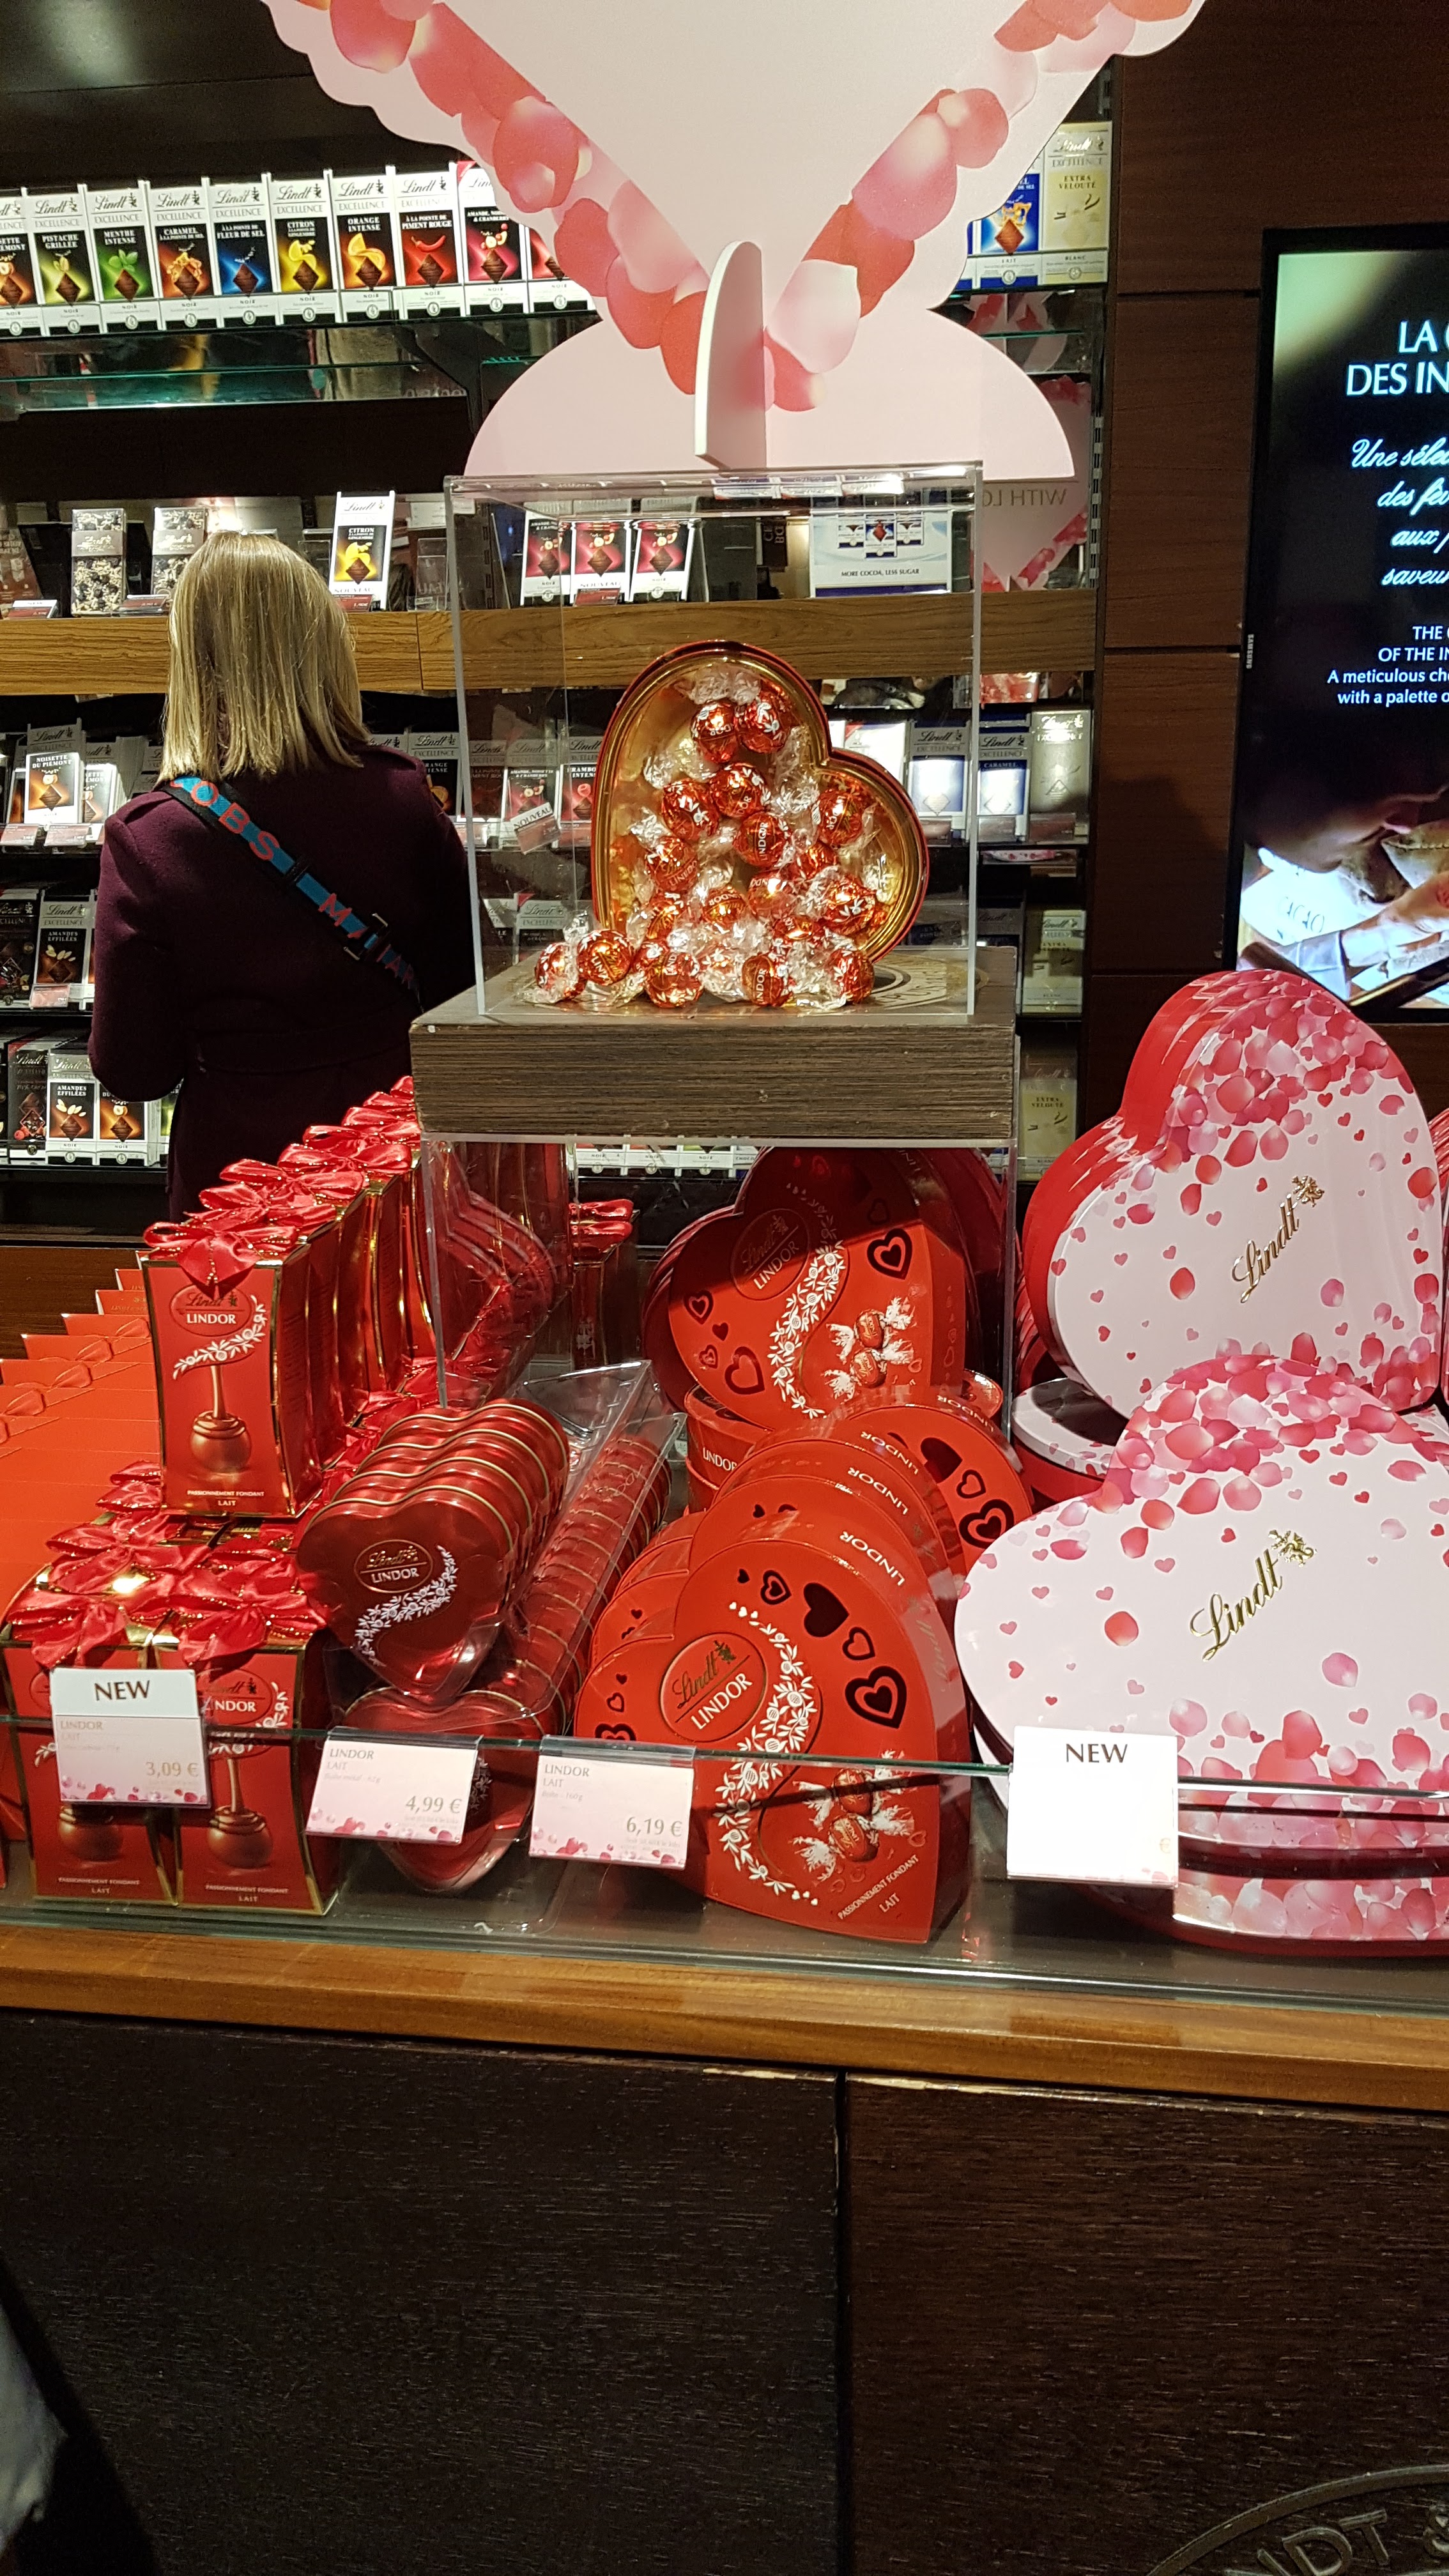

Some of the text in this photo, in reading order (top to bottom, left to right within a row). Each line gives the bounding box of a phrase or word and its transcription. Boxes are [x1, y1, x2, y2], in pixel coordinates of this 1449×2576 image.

[276, 185, 312, 201] Lindt
[337, 182, 374, 197] Lindt
[401, 179, 436, 194] Lindt
[35, 199, 68, 215] Lindt
[95, 194, 128, 210] Lindt
[156, 192, 191, 208] Lindt
[157, 211, 203, 221] EXCELLENCE
[216, 208, 262, 218] EXCELLENCE
[277, 204, 324, 215] EXCELLENCE
[35, 219, 80, 228] EXCELLENCE
[94, 214, 140, 224] EXCELLENCE
[348, 216, 381, 224] ORANGE
[402, 220, 452, 230] PIMENT ROUGE
[163, 227, 199, 236] CARAMEL
[217, 231, 240, 240] FLEUR
[348, 224, 381, 233] INTENSE
[42, 234, 79, 243] PISTACHE
[104, 236, 137, 245] INTENSE
[1399, 320, 1438, 353] LA
[1346, 362, 1408, 396] DES
[1351, 438, 1399, 468] Une
[1377, 480, 1416, 508] des
[344, 501, 376, 512] Lindt
[1390, 529, 1440, 547] aux
[1412, 625, 1443, 640] THE
[1377, 647, 1435, 663] OF THE
[1326, 668, 1426, 684] A meticulous
[1337, 689, 1438, 708] with a palette
[34, 729, 63, 742] Lindt
[415, 735, 448, 746] Lindt
[917, 730, 953, 742] Lindt
[980, 736, 1017, 748] Lindt
[36, 754, 68, 763] NOISETTE
[513, 806, 553, 828] NOUVEAU
[45, 904, 77, 916] Lindt
[523, 903, 555, 916] Lindt
[1232, 1193, 1300, 1304] Lindt
[753, 1240, 799, 1290] LINDOR
[186, 1313, 237, 1325] LINDOR
[861, 1430, 919, 1475] LINDOR
[847, 1467, 909, 1515] LINDOR
[839, 1530, 906, 1586] LINDOR
[371, 1567, 420, 1584] LINDOR
[1189, 1548, 1284, 1662] Lindt
[671, 1650, 718, 1710] Lindt
[94, 1679, 151, 1701] NEW
[214, 1699, 257, 1712] NDOR
[690, 1672, 753, 1731] LINDOR
[60, 1720, 103, 1730] LINDOR
[330, 1748, 375, 1760] LINDOR
[1065, 1743, 1128, 1764] NEW
[145, 1761, 199, 1779] 3,09 €
[326, 1761, 348, 1771] LAIT
[544, 1763, 590, 1777] LINDOR
[542, 1778, 564, 1788] LAIT
[405, 1795, 463, 1814] 4,99 €
[625, 1816, 684, 1837] 6,19 €
[837, 1853, 920, 1920] PASSIONNEMENT FONDANT
[878, 1892, 901, 1913] LAIT
